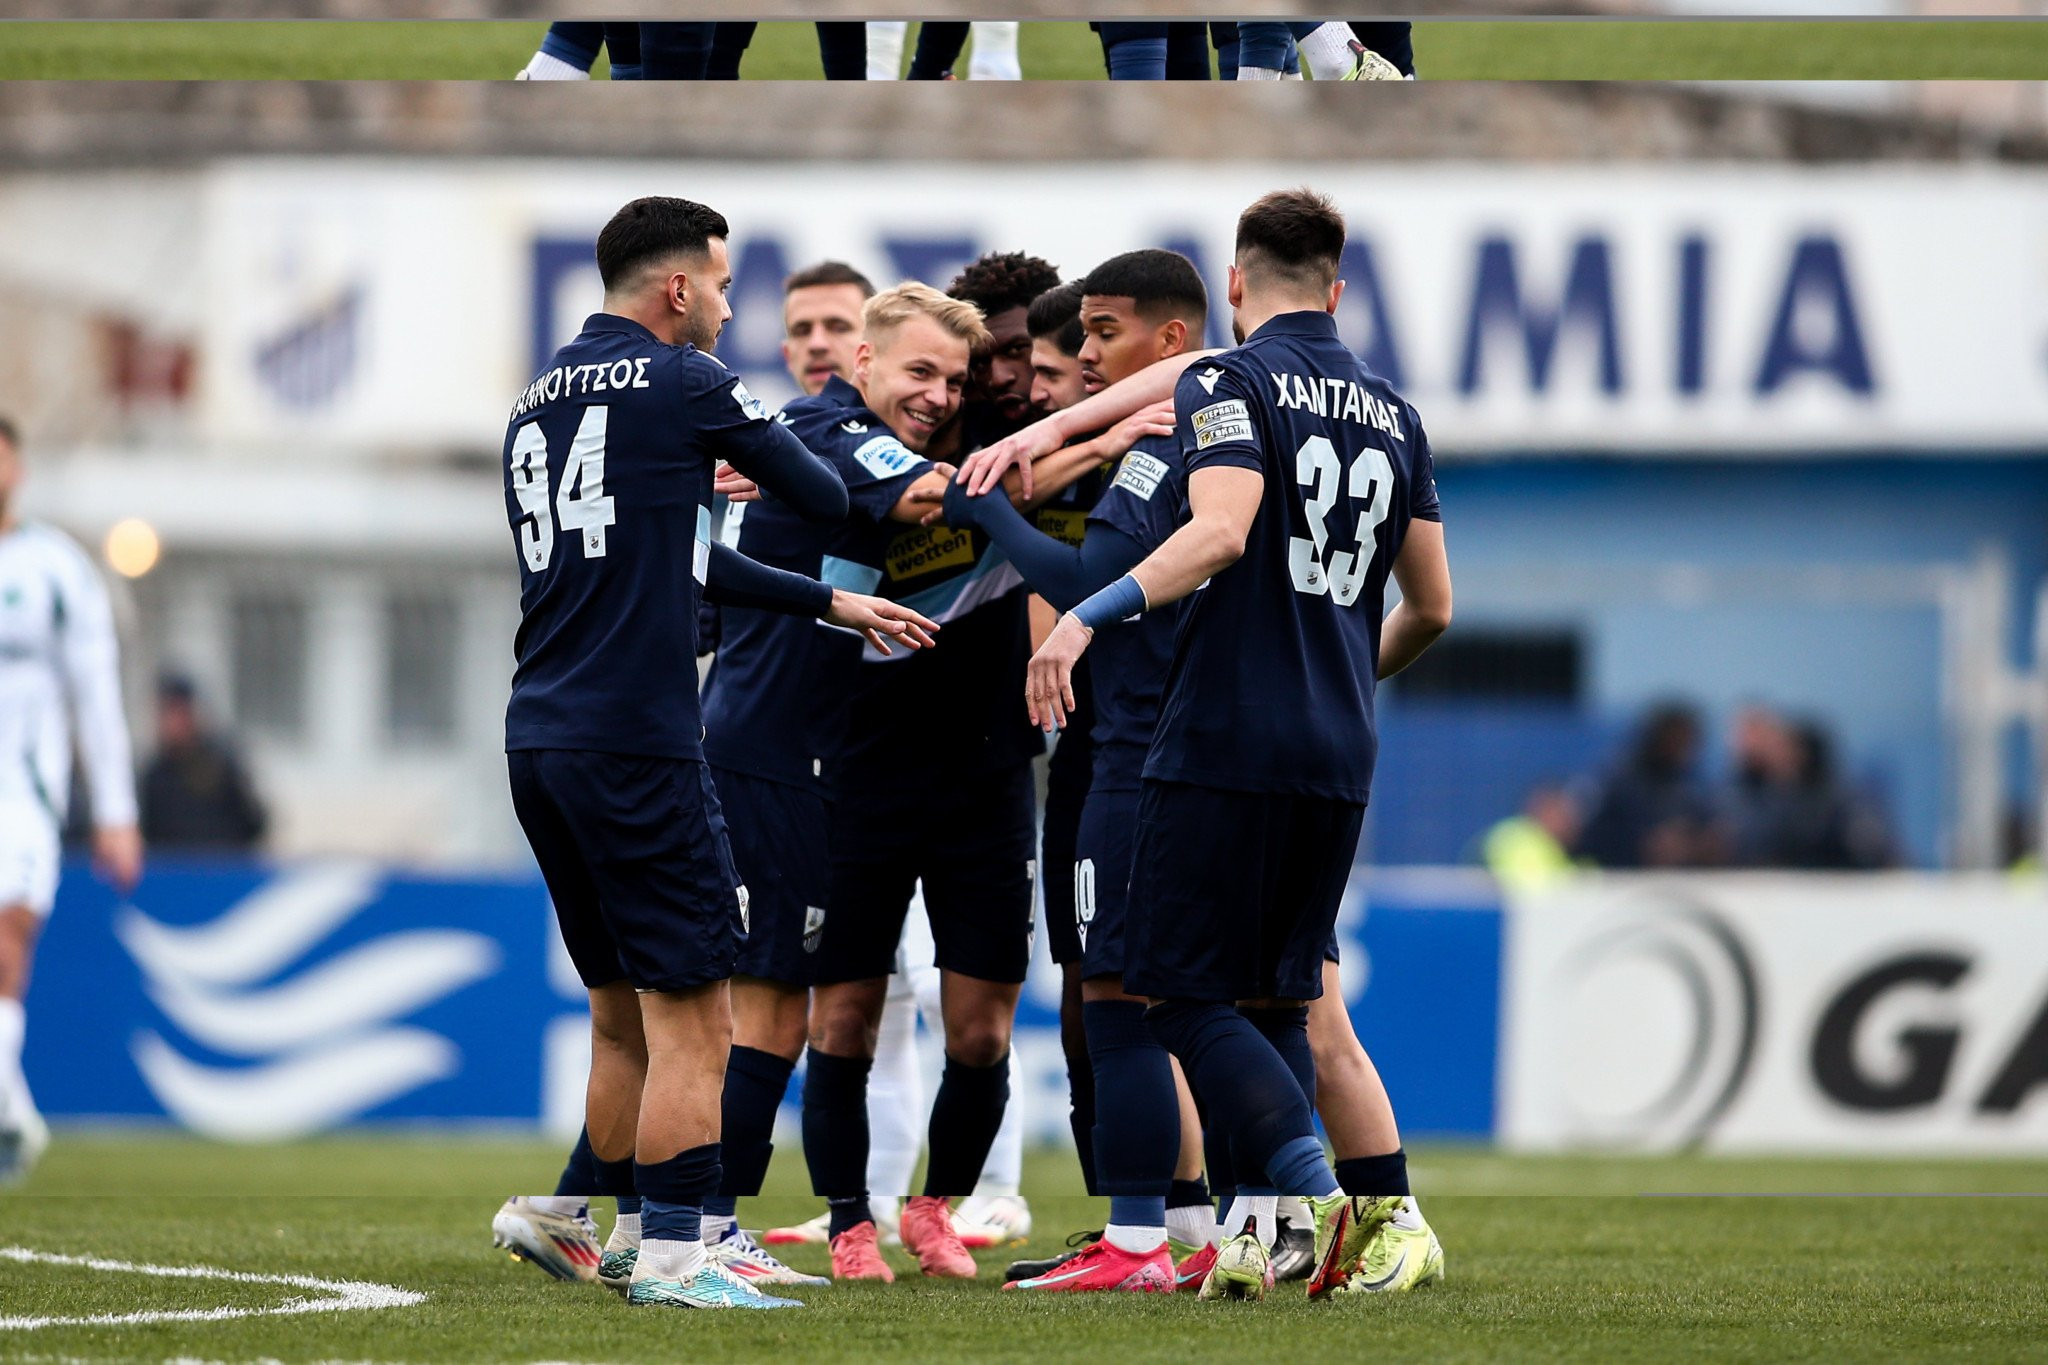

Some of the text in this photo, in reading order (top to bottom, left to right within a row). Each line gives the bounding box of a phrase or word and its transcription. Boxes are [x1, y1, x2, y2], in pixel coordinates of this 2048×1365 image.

[510, 405, 616, 573] 94
[1288, 434, 1395, 607] 33
[895, 532, 968, 574] wetten
[1074, 858, 1096, 924] 10
